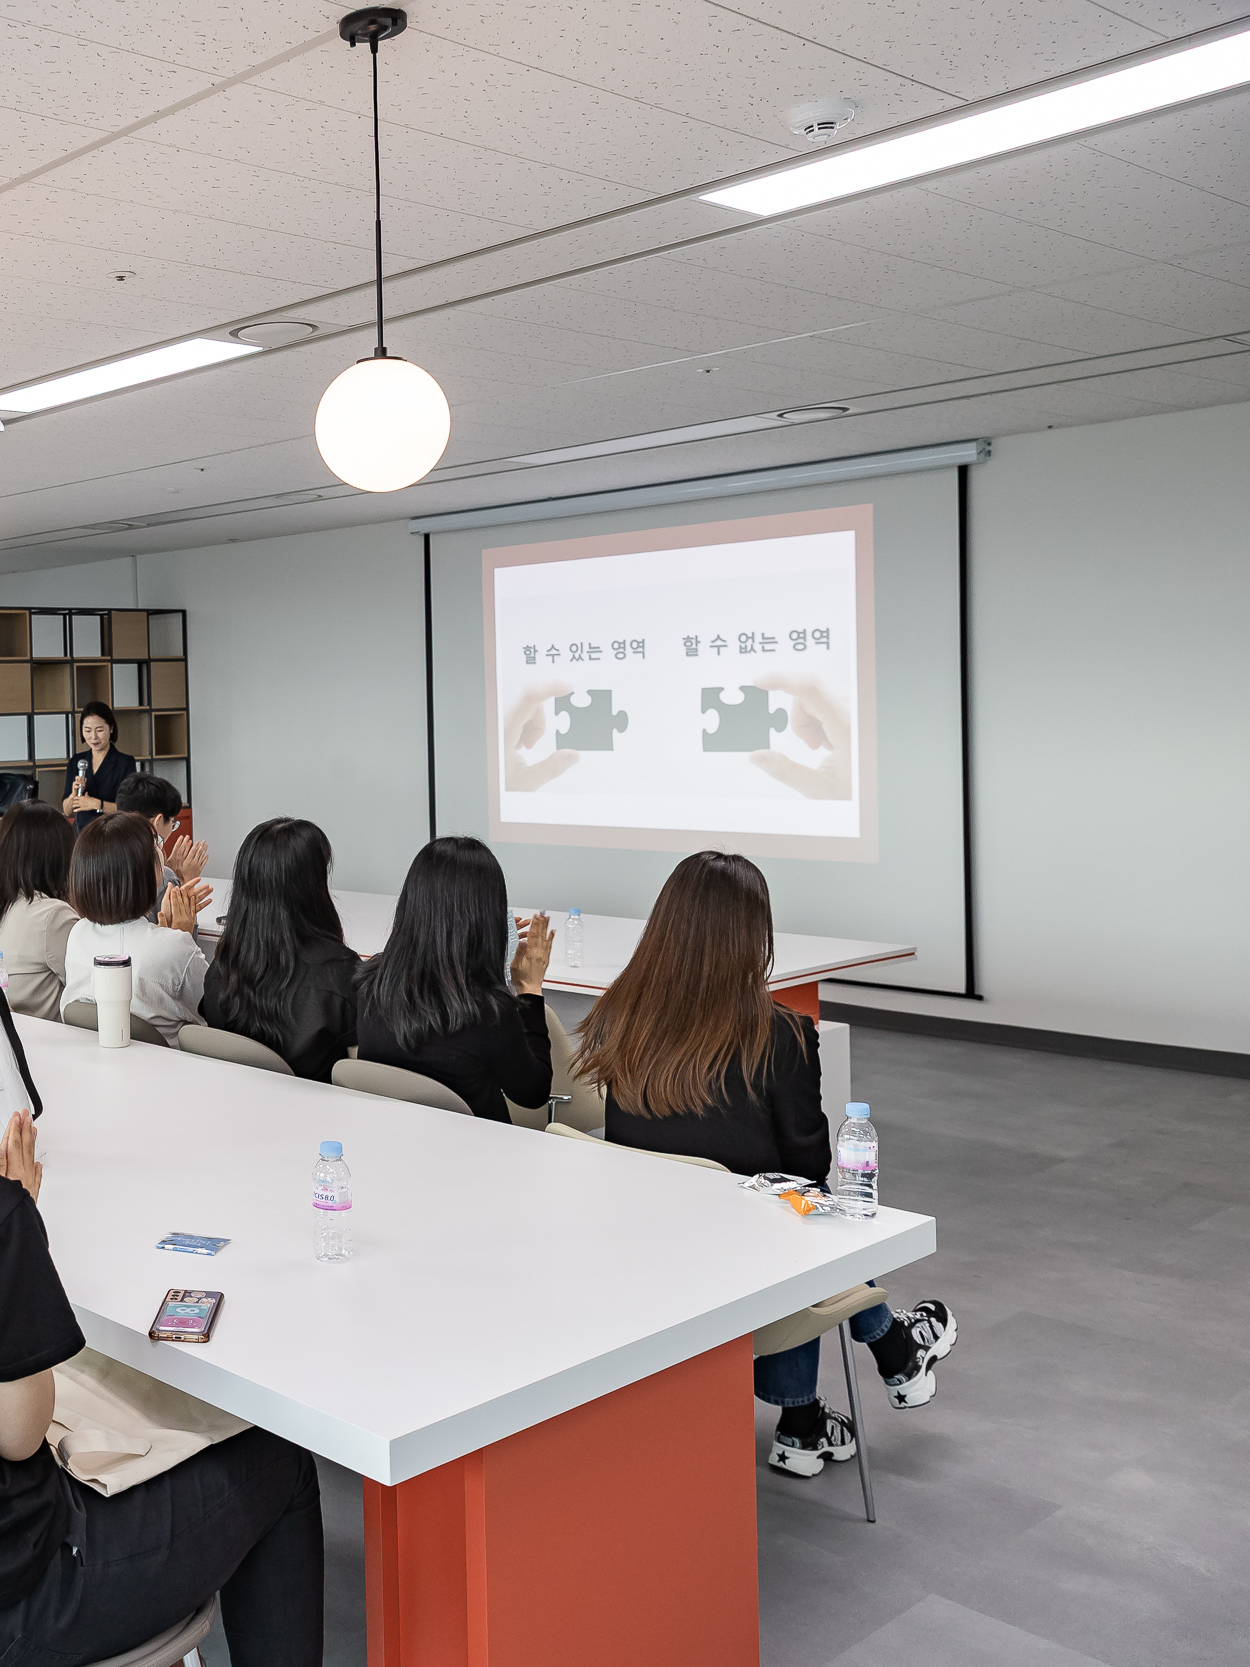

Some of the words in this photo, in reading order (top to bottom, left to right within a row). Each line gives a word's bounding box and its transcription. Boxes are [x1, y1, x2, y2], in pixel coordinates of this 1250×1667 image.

[522, 644, 539, 665] 할
[545, 643, 562, 664] 수
[569, 641, 603, 664] 있는
[610, 637, 647, 660] 영역
[682, 634, 701, 658] 할
[708, 633, 729, 656] 수
[737, 631, 779, 655] 없는
[788, 627, 831, 651] 영역
